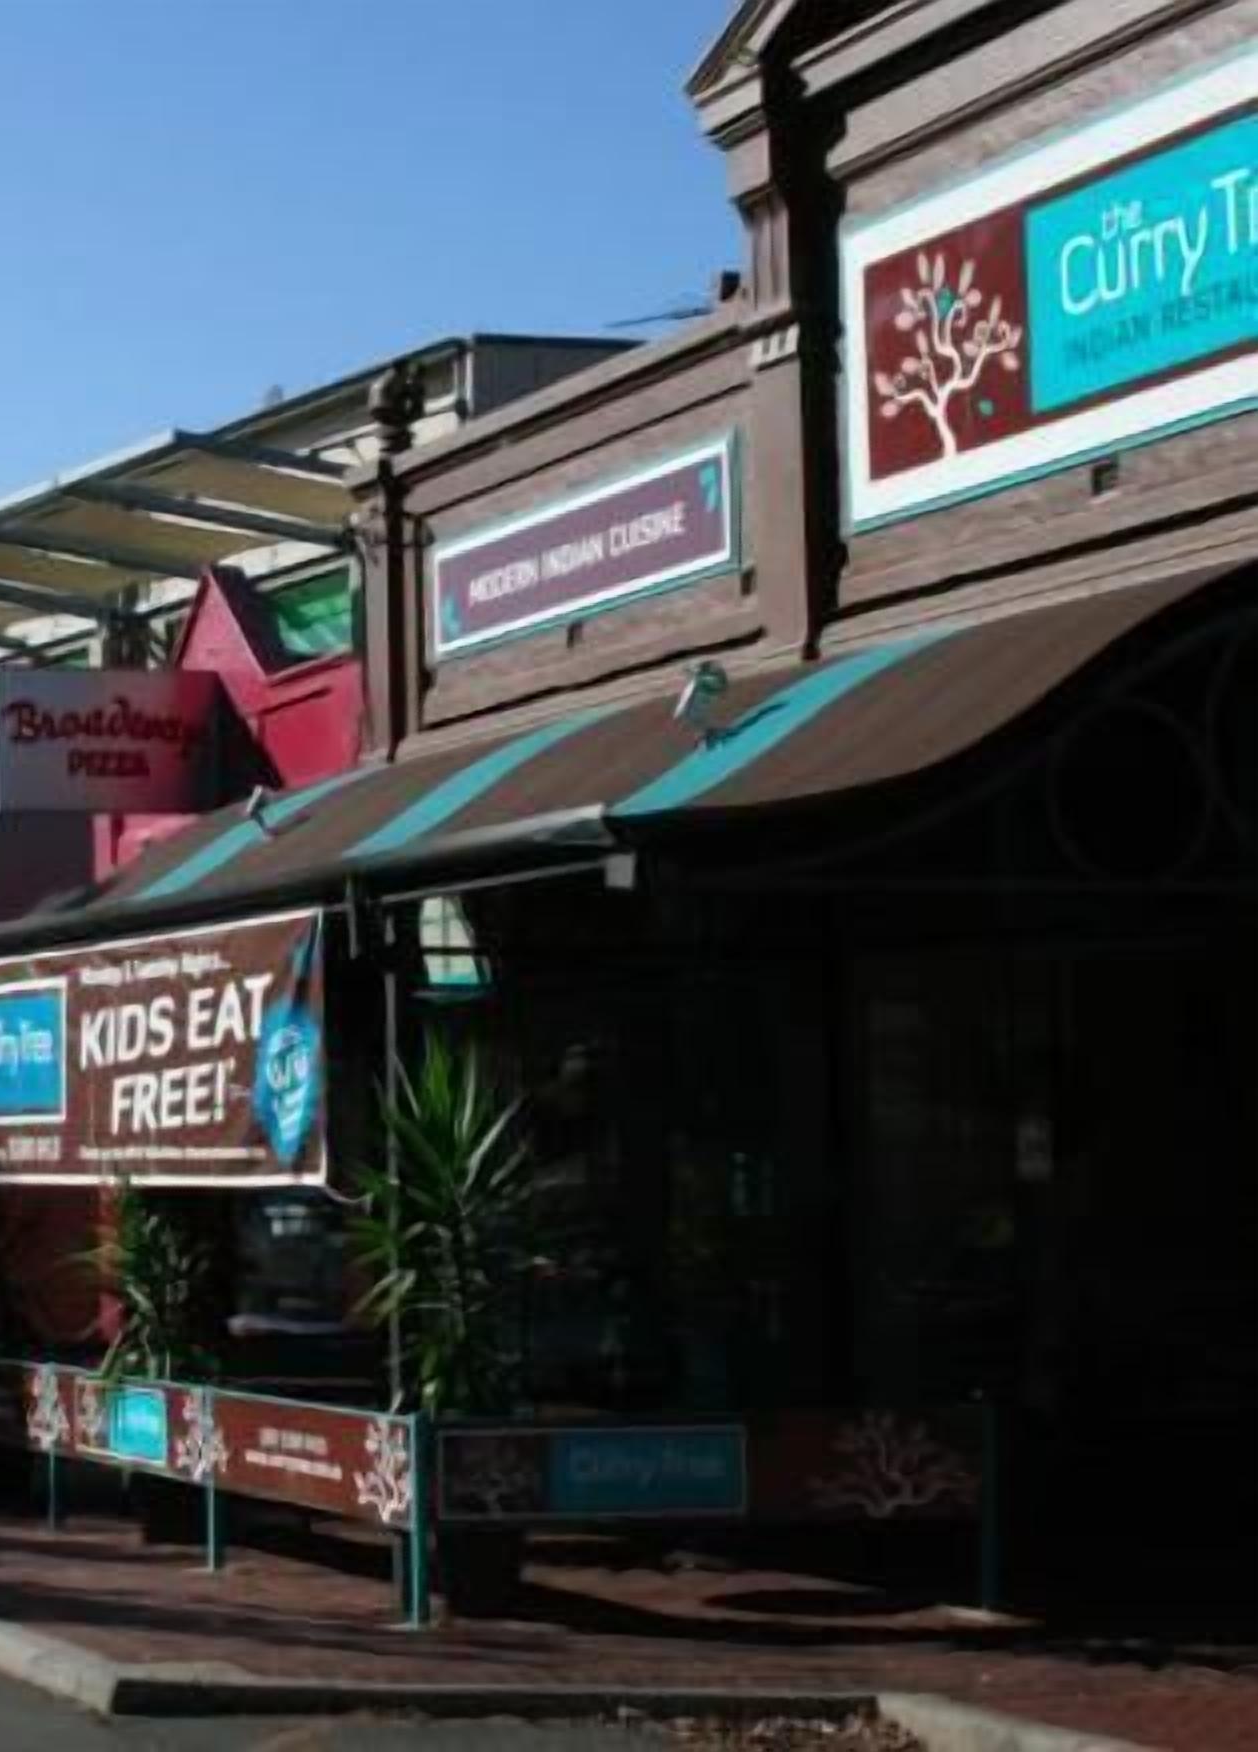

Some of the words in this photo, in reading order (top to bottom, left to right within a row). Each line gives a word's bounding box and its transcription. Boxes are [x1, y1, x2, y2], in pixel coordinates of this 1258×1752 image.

[1060, 204, 1209, 317] Curry
[610, 499, 687, 558] CUISINE
[80, 997, 176, 1070] KIDS
[187, 973, 274, 1050] EAT
[111, 1057, 236, 1136] FREE!
